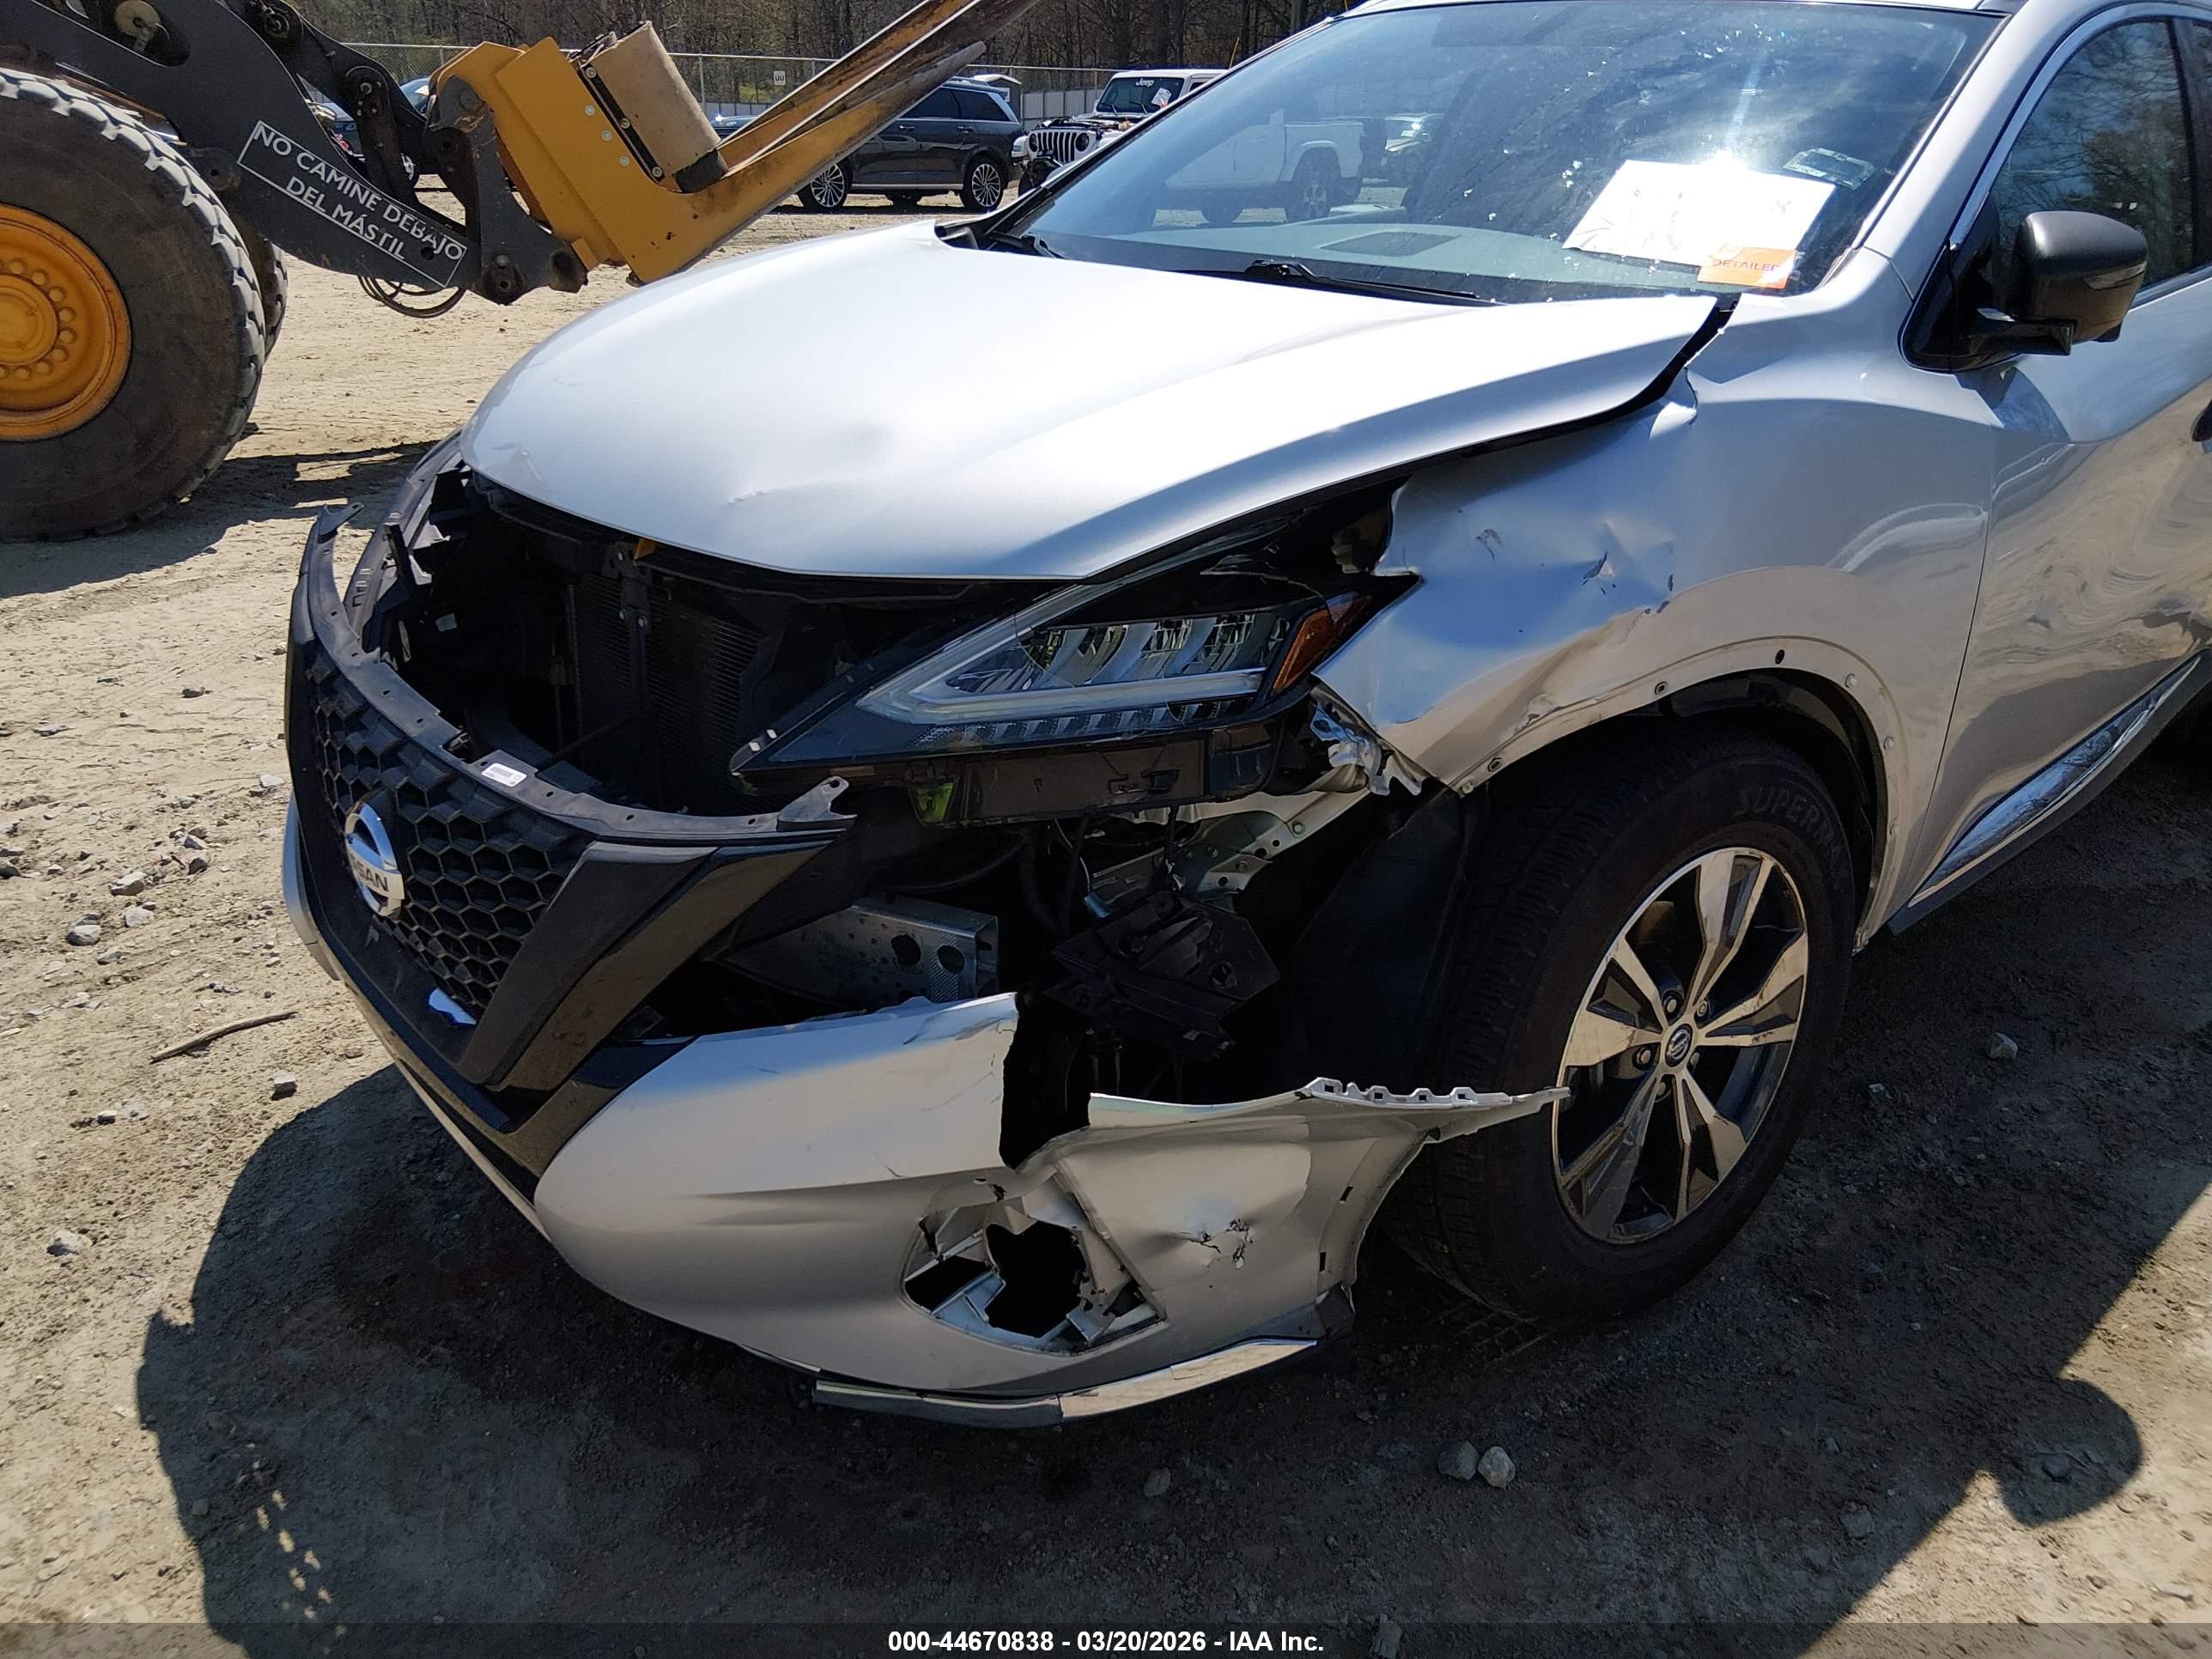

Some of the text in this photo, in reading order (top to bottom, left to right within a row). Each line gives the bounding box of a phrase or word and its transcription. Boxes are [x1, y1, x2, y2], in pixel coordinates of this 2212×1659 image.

[1135, 77, 1154, 88] Jeep
[253, 125, 464, 261] NO CAMINE DEBAJO
[286, 176, 405, 260] DEL MÁSTIL
[351, 854, 390, 893] SAN
